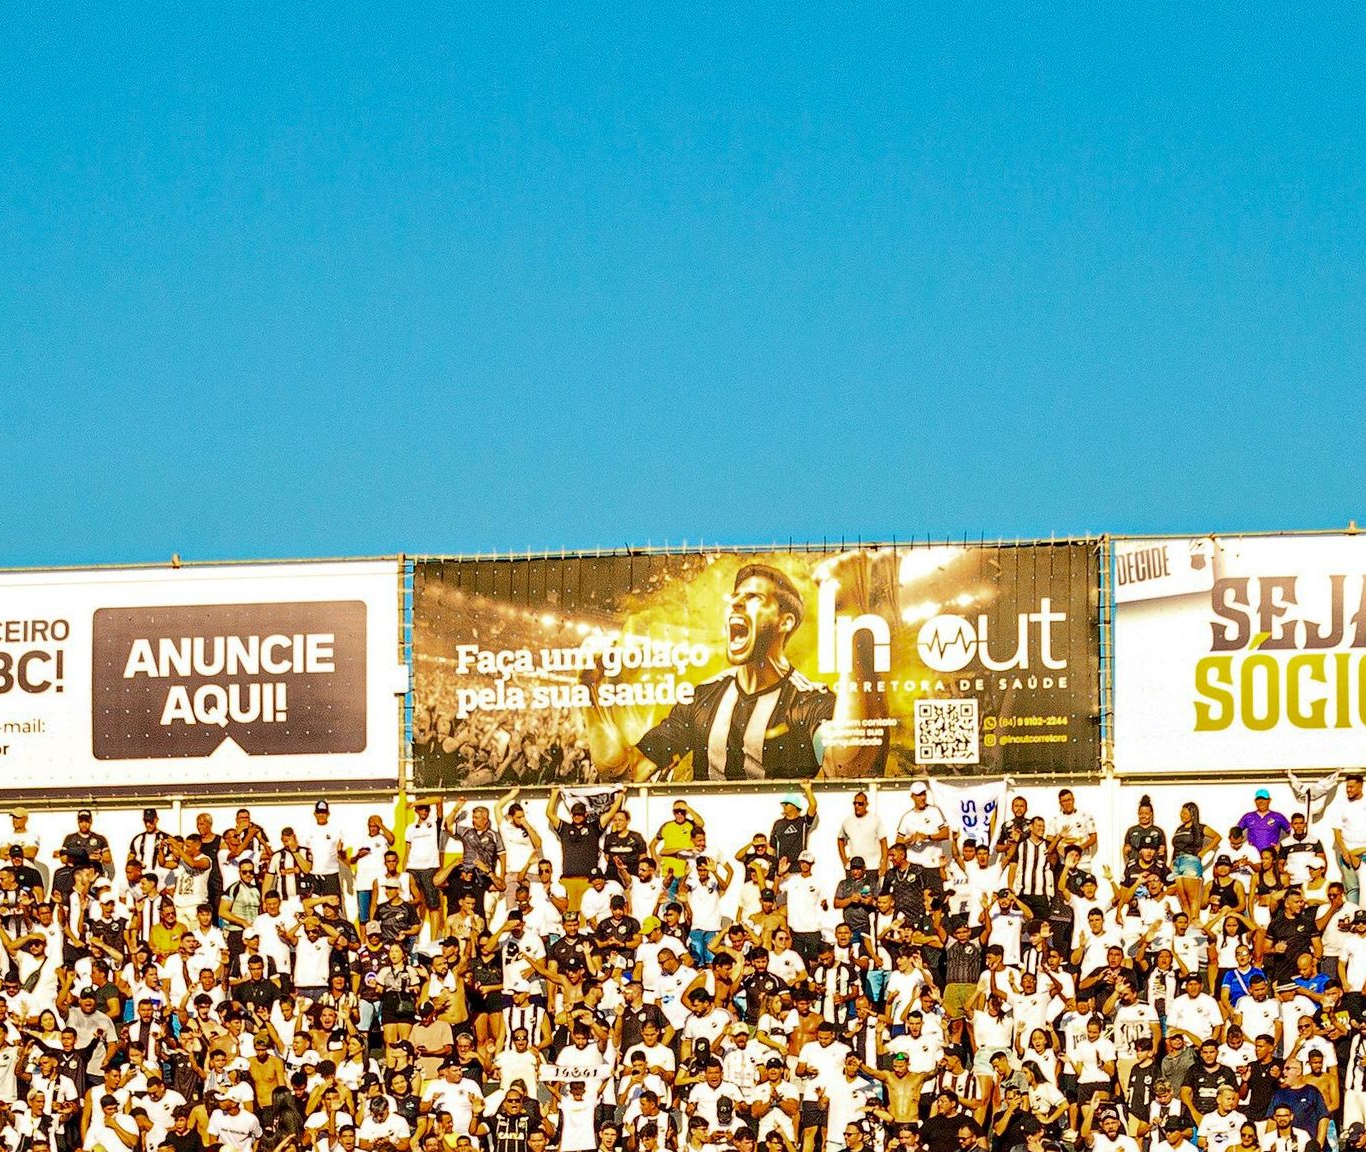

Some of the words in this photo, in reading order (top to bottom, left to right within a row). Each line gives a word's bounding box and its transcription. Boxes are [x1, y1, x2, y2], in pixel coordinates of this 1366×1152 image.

[1116, 545, 1171, 586] DECIDE
[123, 633, 336, 679] ANUNCIE
[456, 642, 533, 681] Faça
[540, 642, 596, 674] um
[600, 636, 709, 680] golaço
[818, 598, 891, 674] In
[159, 683, 287, 727] AQUI!
[456, 682, 524, 721] pela
[529, 683, 590, 711] sua
[596, 674, 695, 709] saúde
[959, 679, 984, 692] DE
[998, 675, 1068, 690] SAÚDE
